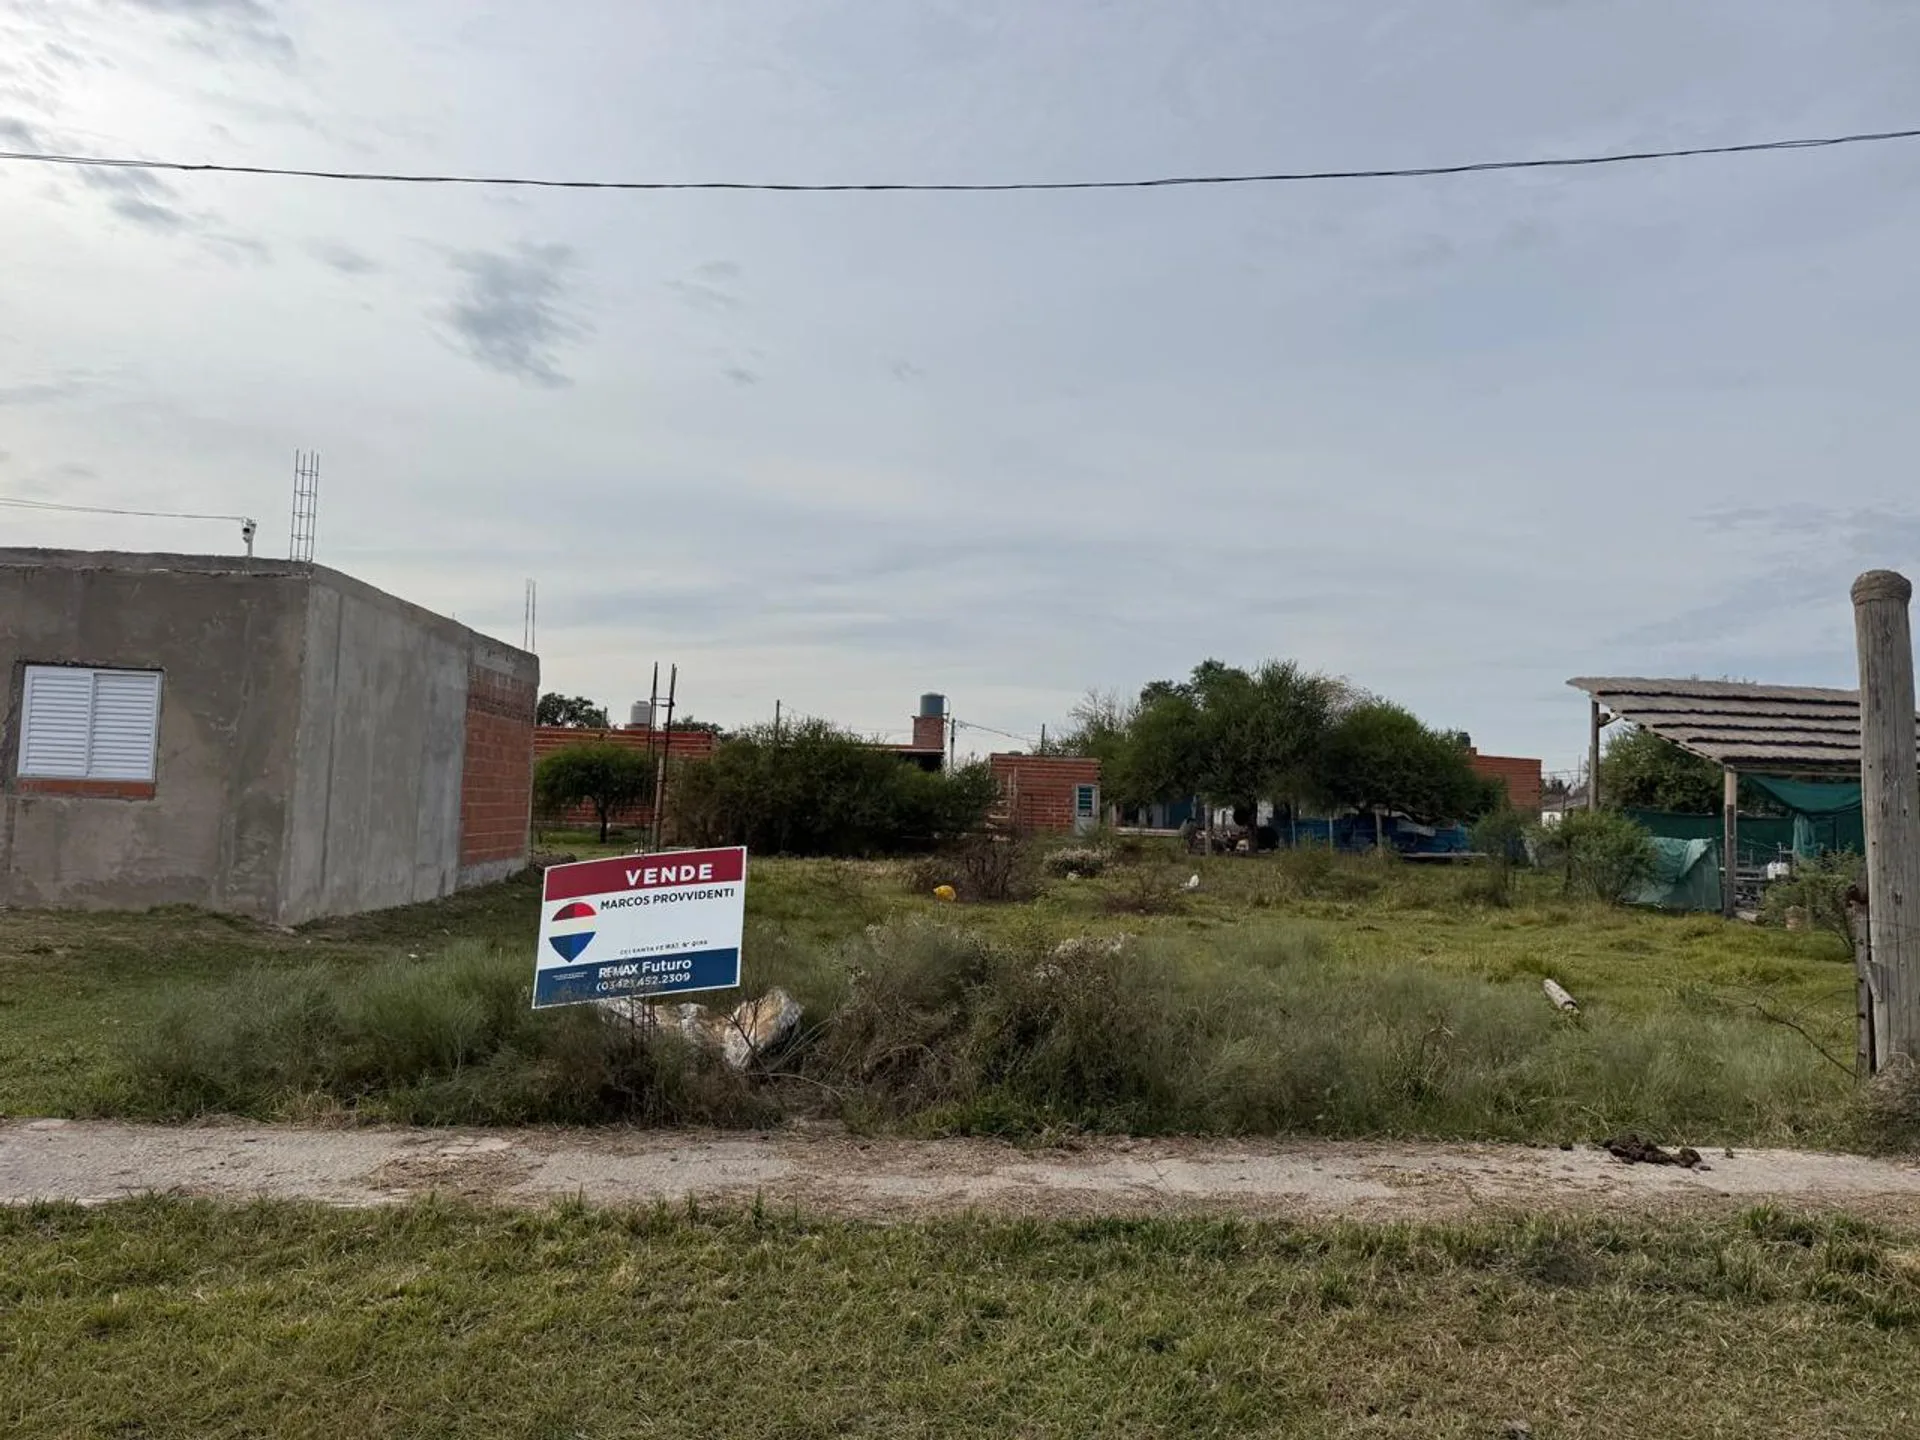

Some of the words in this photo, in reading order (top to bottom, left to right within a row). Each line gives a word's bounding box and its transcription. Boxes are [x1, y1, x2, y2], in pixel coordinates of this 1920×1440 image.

[626, 863, 713, 886] VENDE
[600, 895, 650, 910] MARCOS
[653, 888, 735, 904] PROVVIDENTI
[642, 959, 692, 973] Futuro
